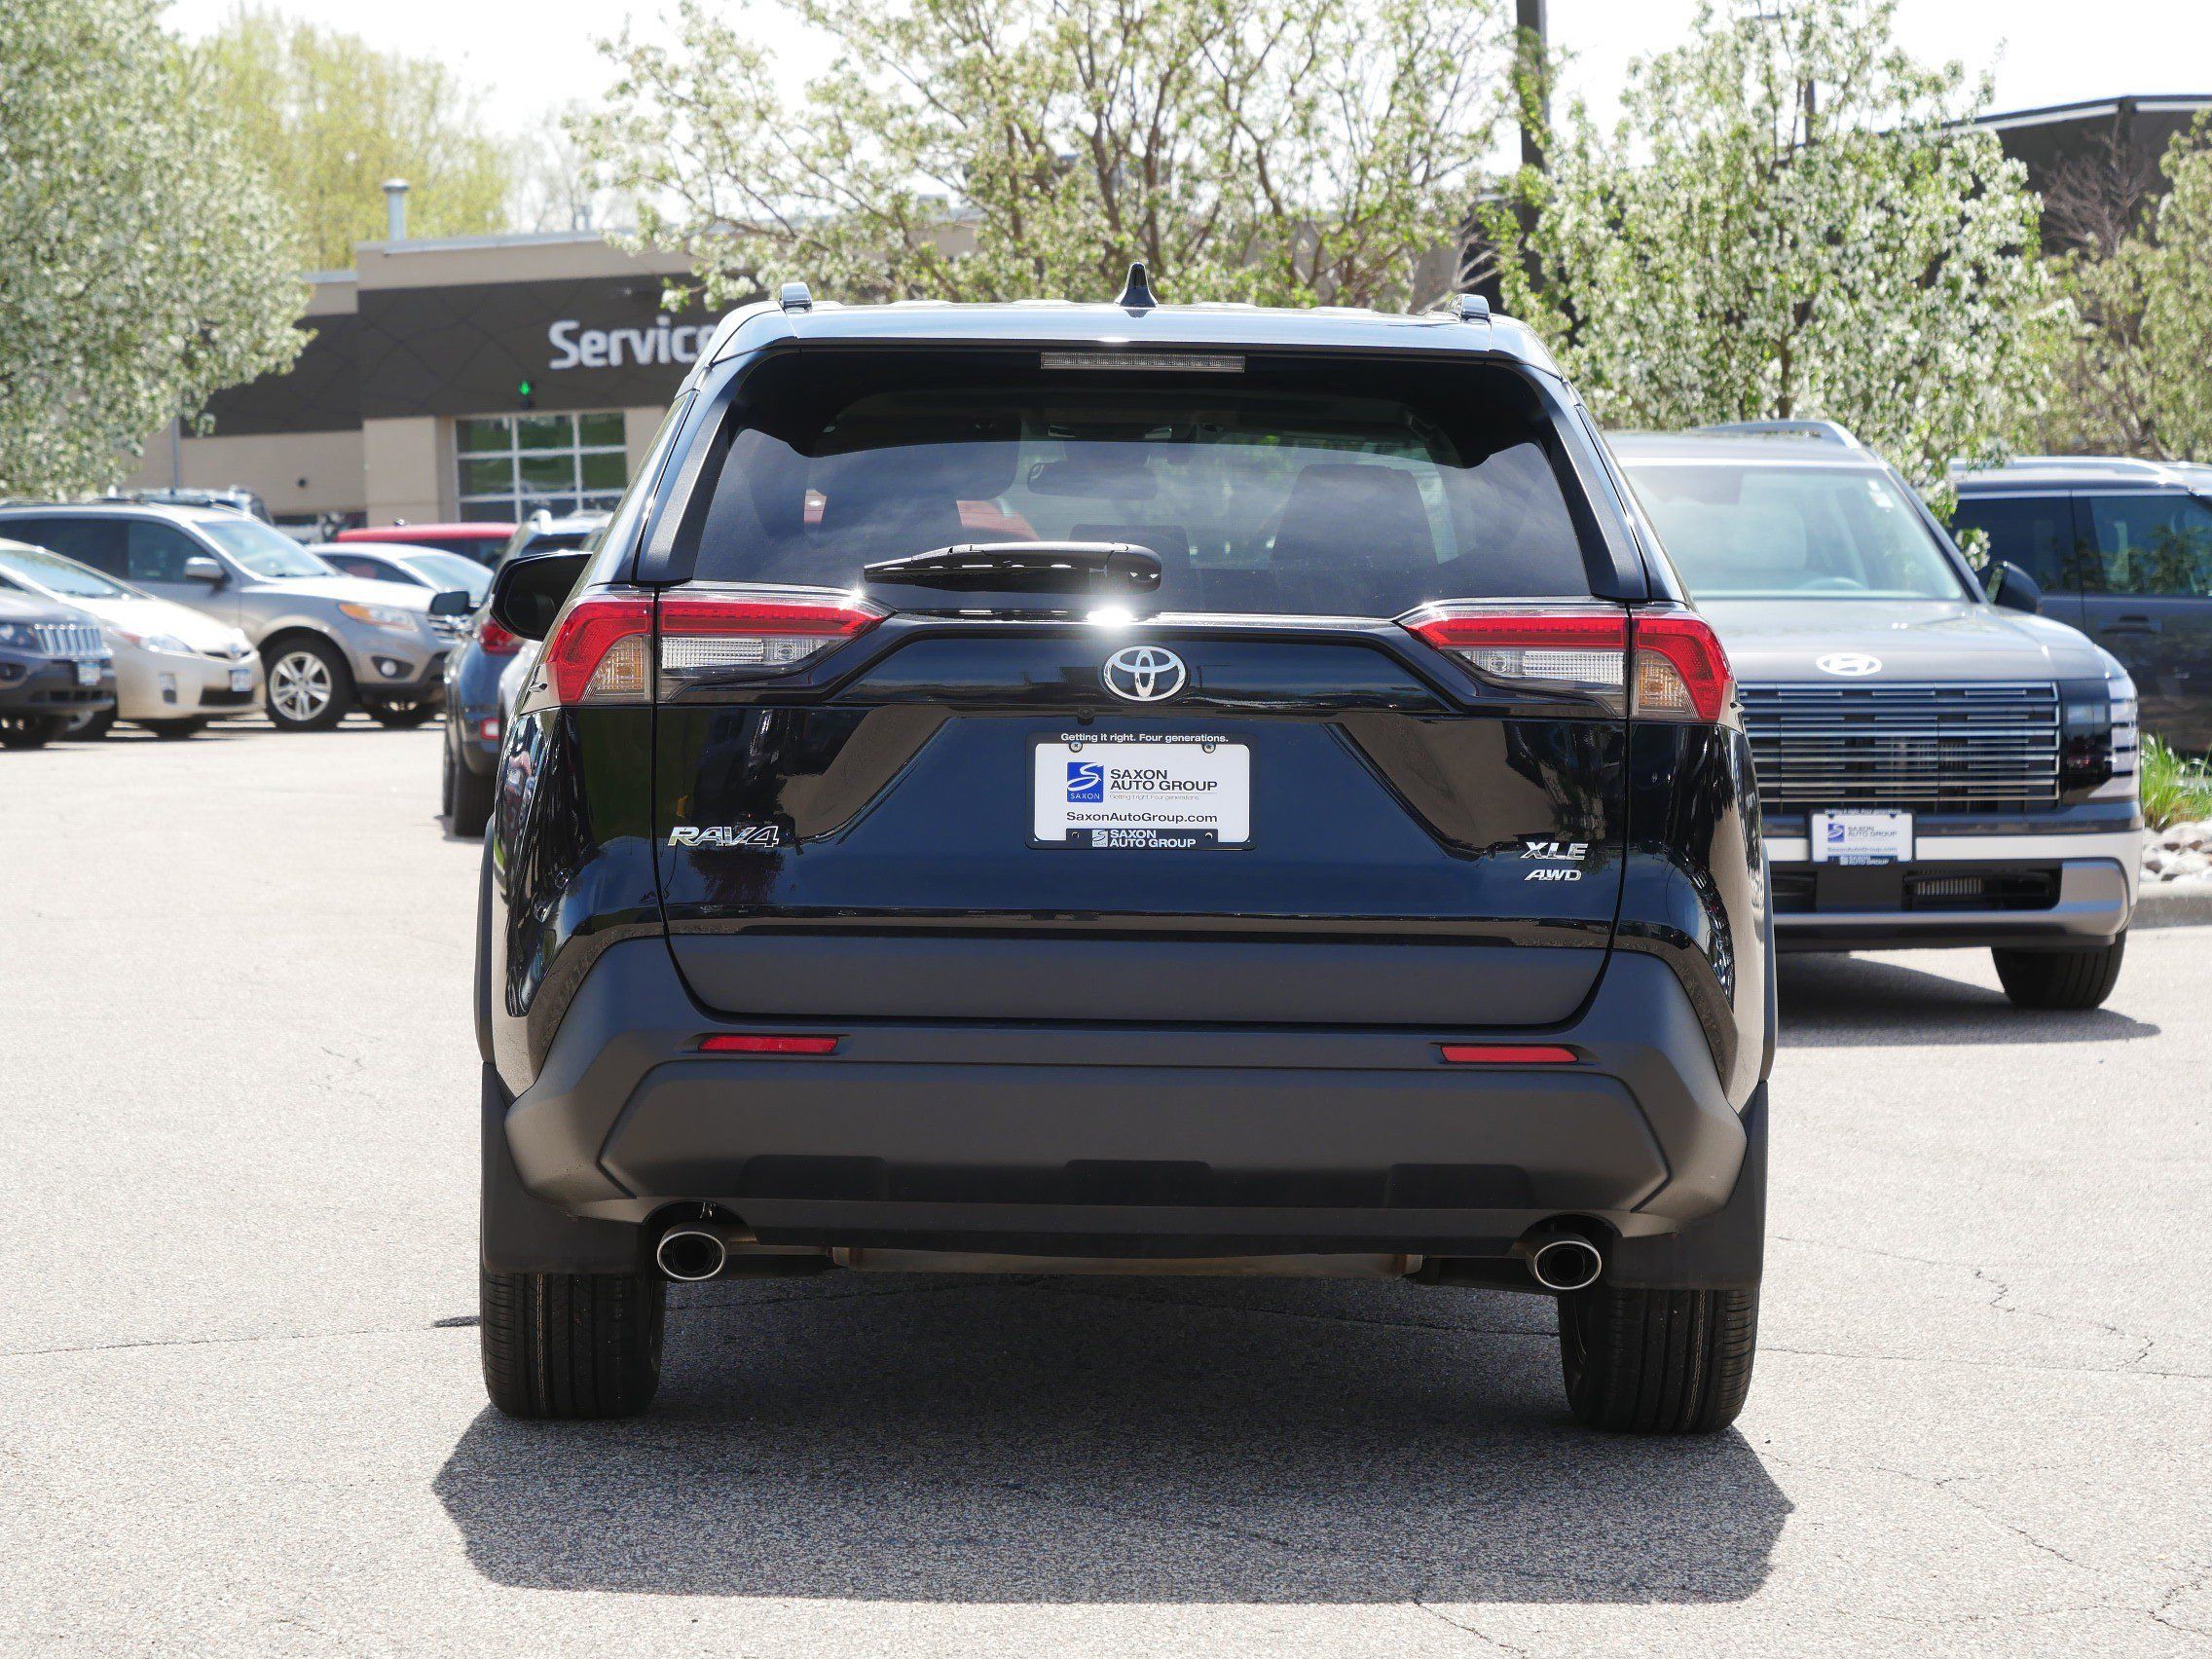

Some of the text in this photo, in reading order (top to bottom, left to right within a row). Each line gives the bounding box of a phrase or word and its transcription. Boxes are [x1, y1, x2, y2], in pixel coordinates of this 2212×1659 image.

[1060, 733, 1098, 743] Getting
[1110, 733, 1136, 743] right.
[1139, 733, 1162, 742] Four
[1165, 734, 1229, 744] generations.
[1110, 769, 1167, 780] SAXON
[1110, 780, 1218, 792] AUTO GROUP
[1066, 811, 1218, 824] SaxonAutoGroup.com
[668, 827, 779, 848] RAV4
[1110, 830, 1157, 839] SAXON
[1109, 838, 1146, 848] AUTO
[1149, 838, 1197, 848] GROUP
[1520, 841, 1589, 861] XLE
[1524, 869, 1582, 881] AWD
